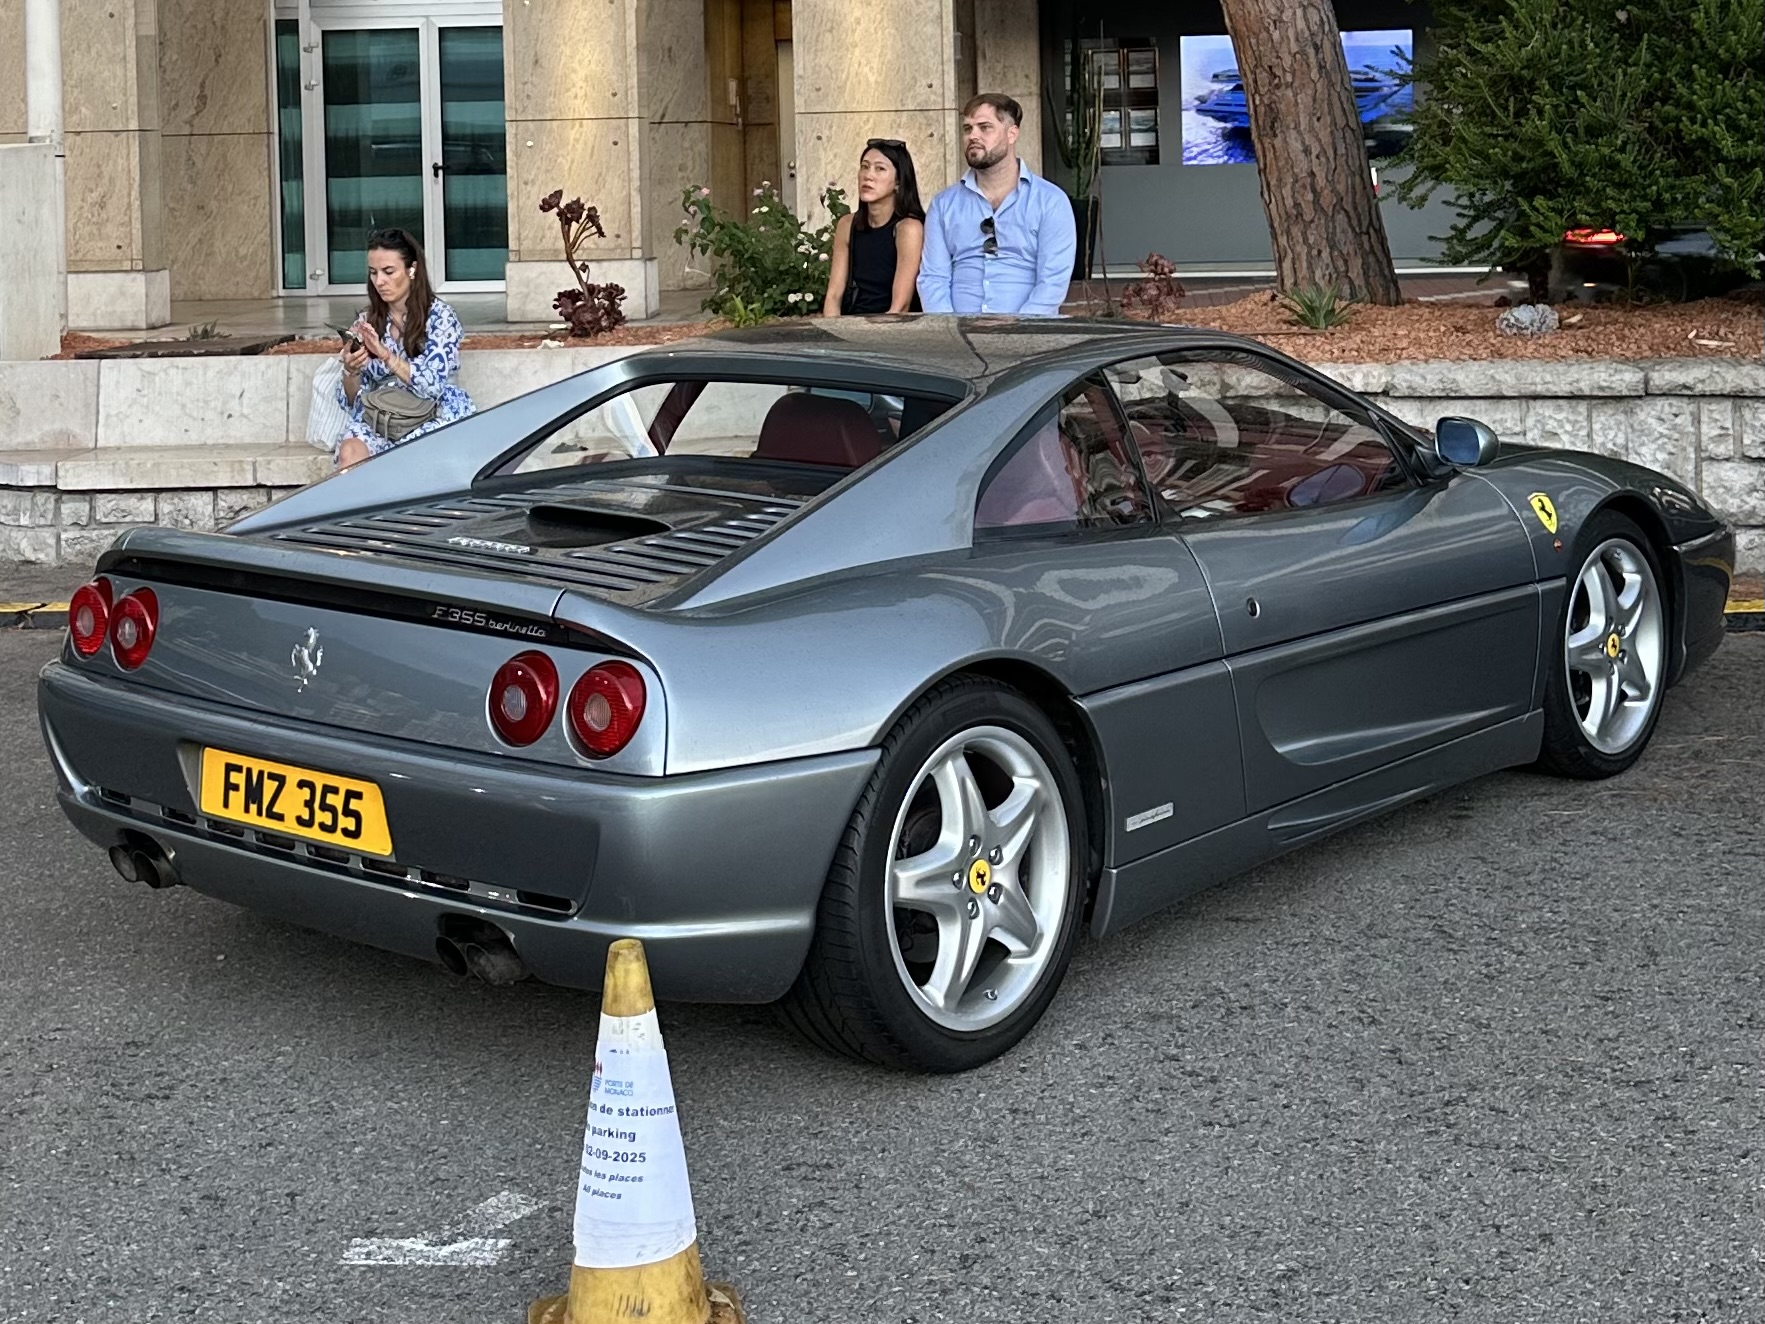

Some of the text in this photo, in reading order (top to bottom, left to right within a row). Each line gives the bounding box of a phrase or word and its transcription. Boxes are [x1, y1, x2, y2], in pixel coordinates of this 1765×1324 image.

[432, 605, 487, 626] F355
[223, 762, 364, 840] FMZ 355
[599, 1103, 613, 1115] de
[591, 1126, 637, 1142] parking
[608, 1173, 644, 1183] places
